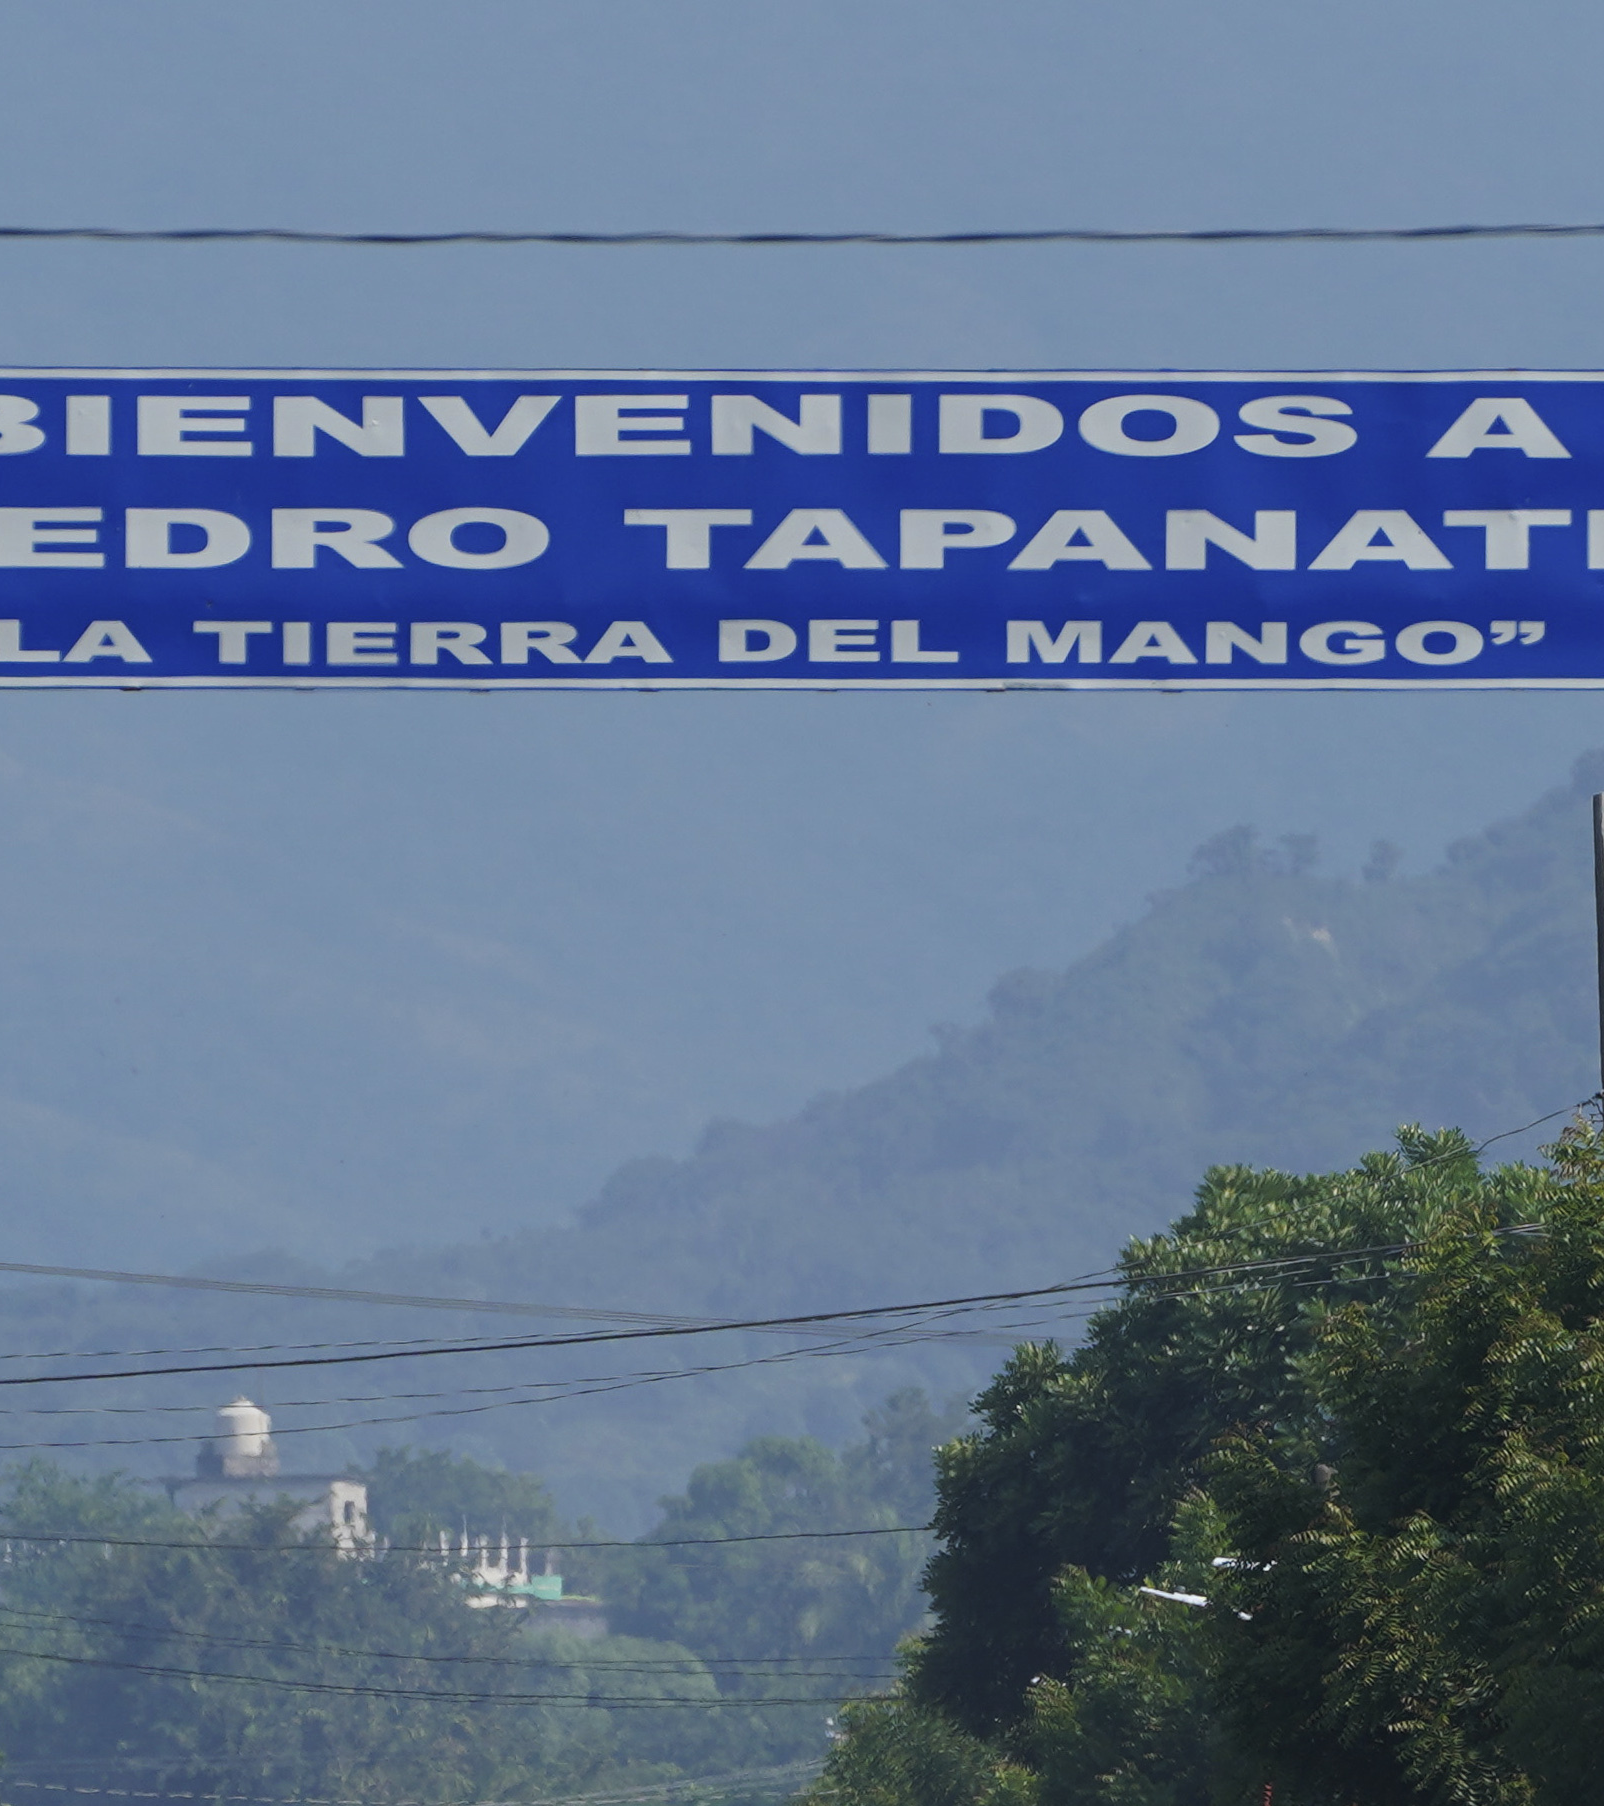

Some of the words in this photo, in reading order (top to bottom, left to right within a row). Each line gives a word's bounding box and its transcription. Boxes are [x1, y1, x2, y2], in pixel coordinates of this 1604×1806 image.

[1425, 397, 1572, 459] A
[193, 620, 674, 665] TIERRA
[718, 619, 960, 663] DEL
